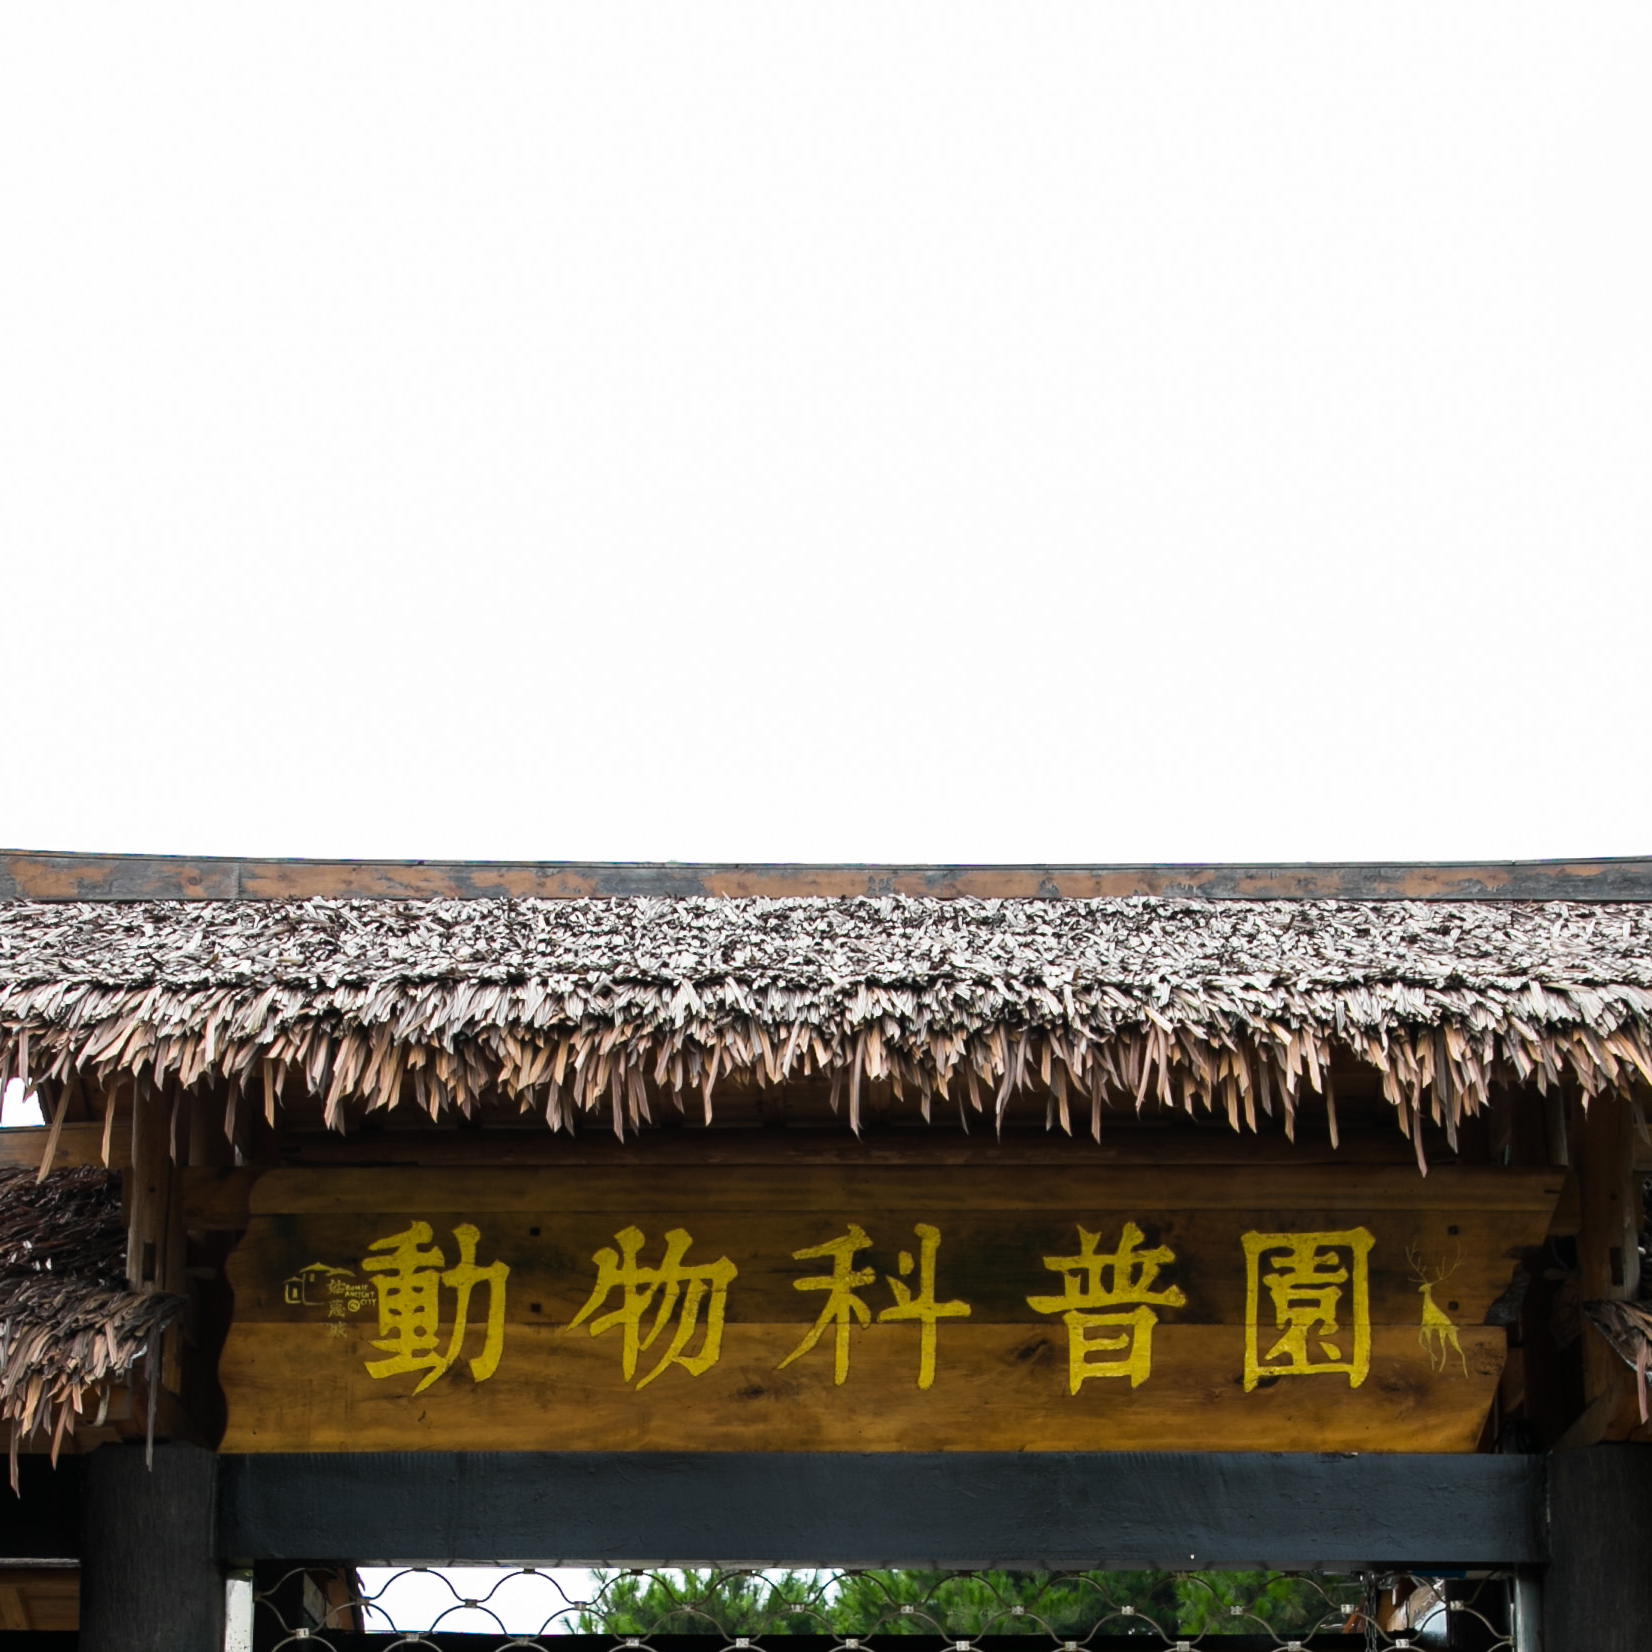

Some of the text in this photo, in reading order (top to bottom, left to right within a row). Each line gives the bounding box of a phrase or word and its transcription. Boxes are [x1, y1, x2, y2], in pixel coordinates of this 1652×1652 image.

[360, 1219, 1377, 1397] 動物科普園
